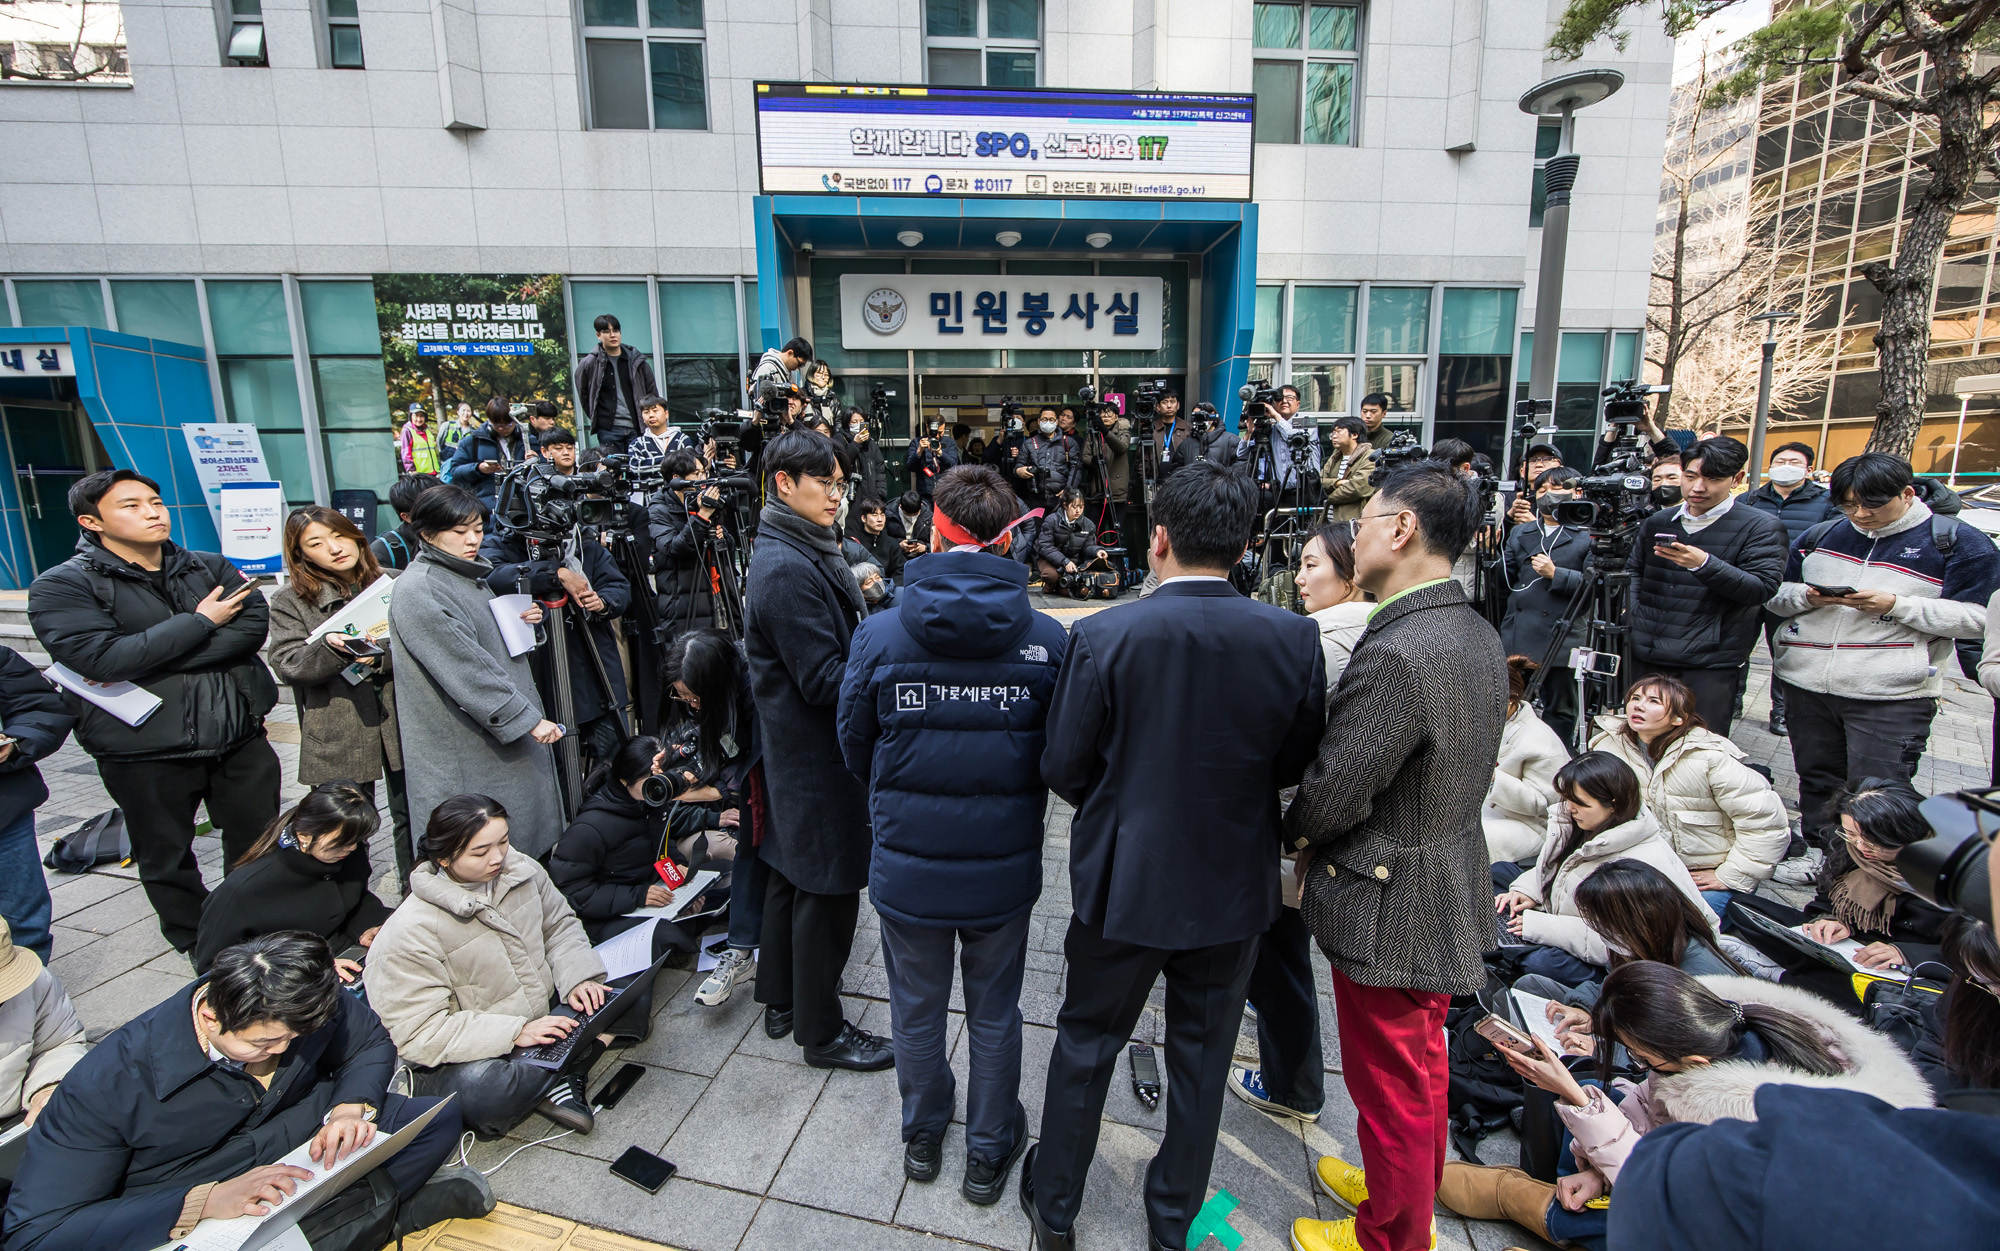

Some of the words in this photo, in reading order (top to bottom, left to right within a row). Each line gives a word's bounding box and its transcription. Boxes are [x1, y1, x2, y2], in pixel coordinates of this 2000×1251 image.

[850, 128, 971, 157] 함께합니다
[975, 131, 1038, 161] SPO,
[1043, 132, 1135, 161] 신고해요
[1137, 135, 1168, 161] 117
[844, 178, 889, 190] 국번없이
[892, 177, 911, 190] 117
[946, 178, 968, 190] 문자
[974, 178, 1013, 192] #0117
[1052, 181, 1096, 194] 안전드림
[405, 303, 452, 320] 사회적
[455, 303, 488, 320] 약자
[490, 303, 538, 320] 보호에
[929, 290, 1139, 336] 민원봉사실
[401, 322, 449, 340] 최선을
[452, 322, 546, 340] 다하겠습니다
[473, 345, 500, 353] 노인학대
[501, 345, 515, 353] 신고
[199, 456, 259, 465] 보이스피싱제로
[216, 464, 248, 472] 2차년도
[930, 685, 1031, 711] 가로세로연구소
[664, 862, 680, 882] PRESS
